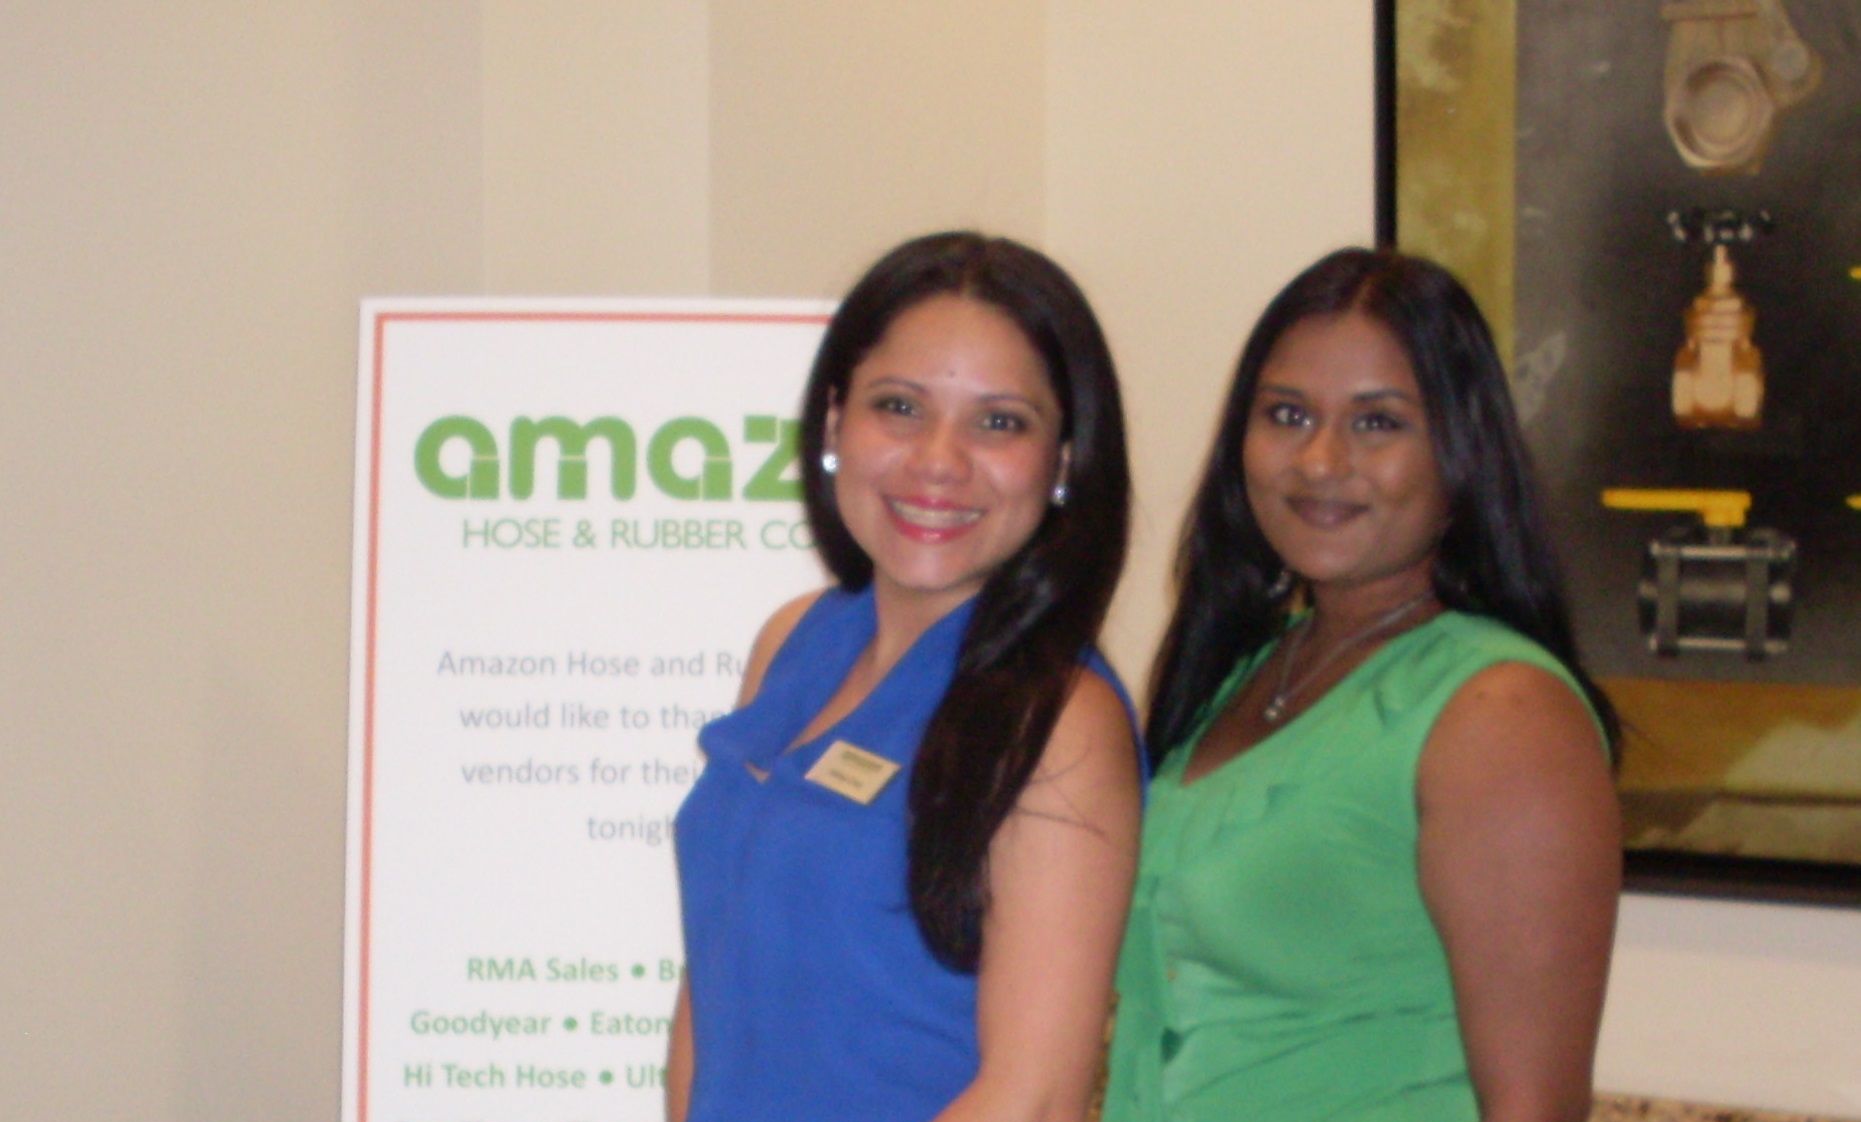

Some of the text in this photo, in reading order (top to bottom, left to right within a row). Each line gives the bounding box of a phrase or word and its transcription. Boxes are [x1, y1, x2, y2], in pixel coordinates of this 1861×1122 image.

[462, 518, 563, 549] HOSE
[572, 518, 597, 549] &
[610, 519, 747, 550] RUBBER
[437, 651, 556, 677] Amazon
[566, 651, 640, 677] Hose
[649, 651, 704, 677] and
[460, 703, 550, 729] would
[561, 703, 609, 729] like
[620, 706, 650, 729] to
[461, 759, 579, 785] vendors
[589, 757, 631, 785] for
[467, 957, 537, 983] RMA
[546, 957, 619, 983] Sales
[410, 1010, 672, 1040] Goodyear Eaton
[403, 1063, 432, 1089] Hi
[442, 1063, 505, 1089] Tech
[516, 1064, 587, 1089] Hose
